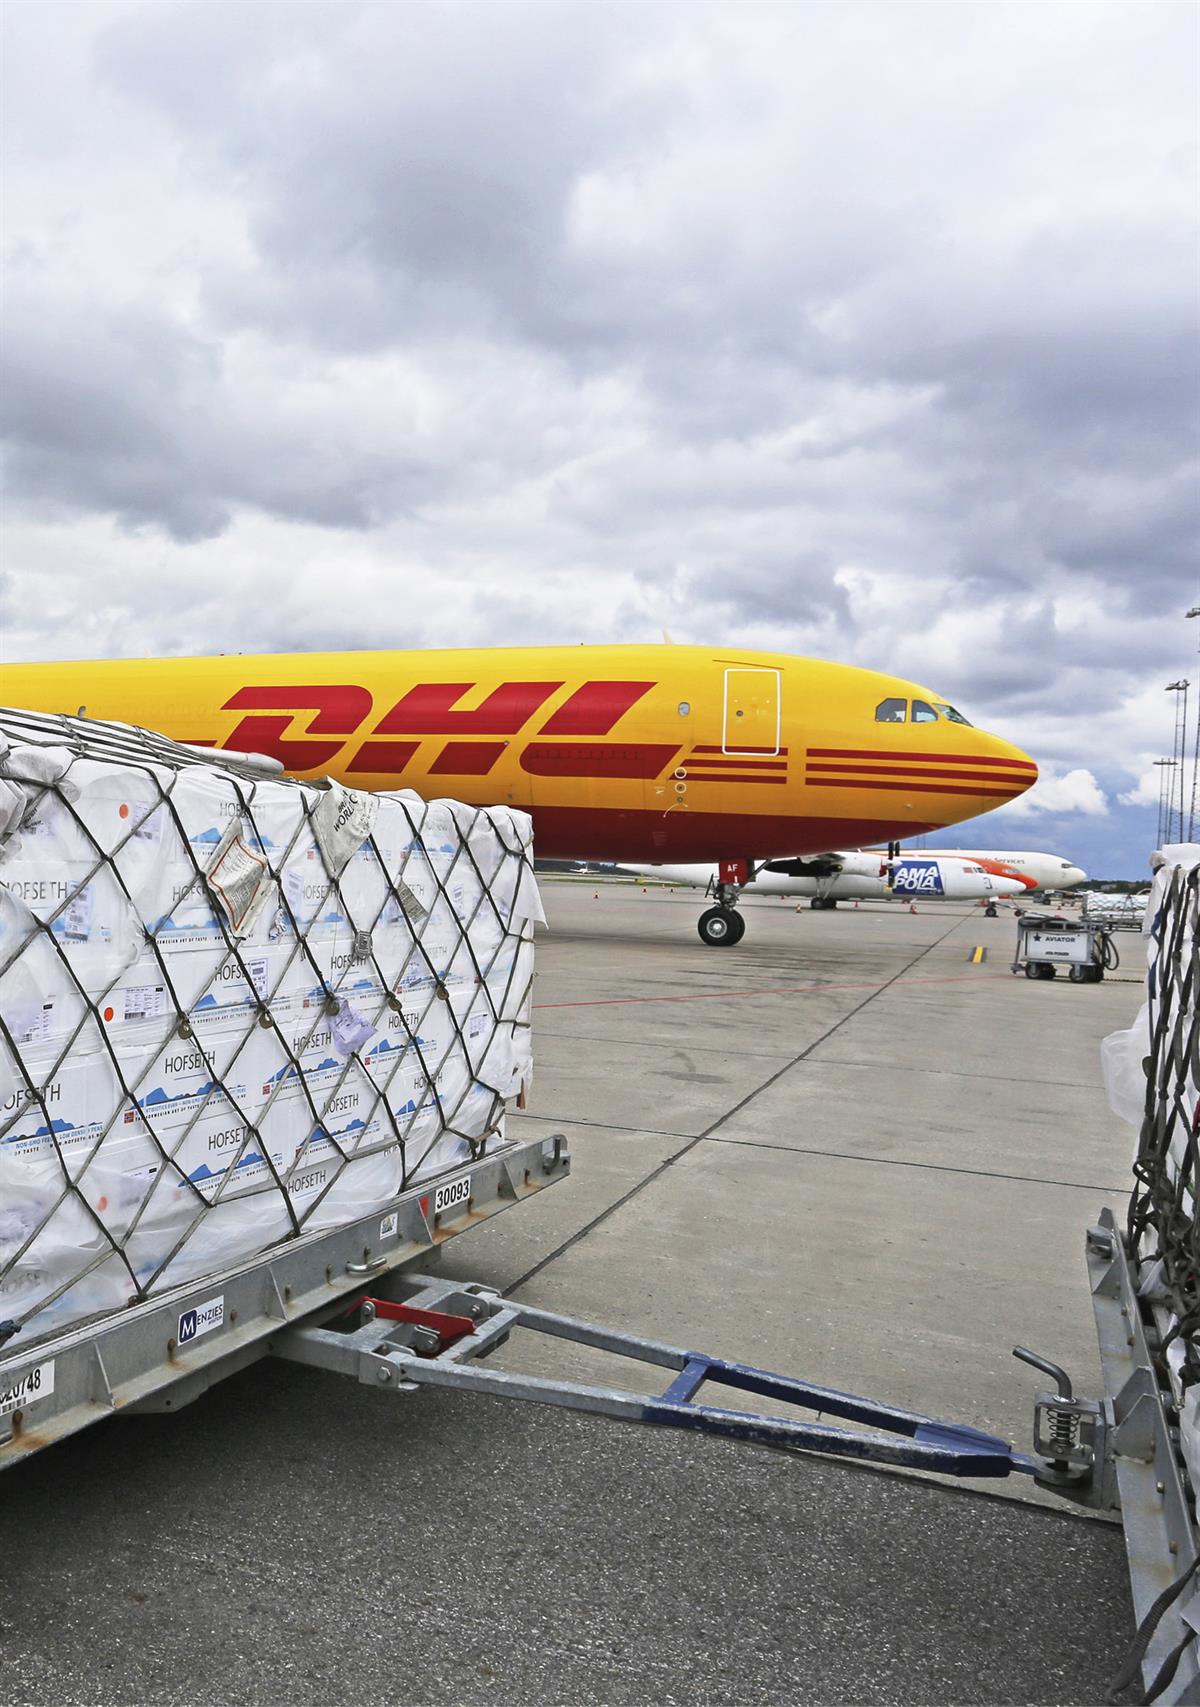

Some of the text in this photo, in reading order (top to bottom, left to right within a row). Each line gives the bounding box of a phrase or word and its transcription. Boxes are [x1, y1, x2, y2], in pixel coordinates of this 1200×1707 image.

[220, 681, 683, 780] DHL
[333, 801, 354, 832] WORL
[727, 863, 738, 872] AF
[895, 866, 938, 878] AMA
[894, 877, 937, 891] POLA
[23, 1147, 40, 1155] TASTE
[287, 1169, 327, 1193] HOFSETH
[436, 1180, 469, 1209] 30093
